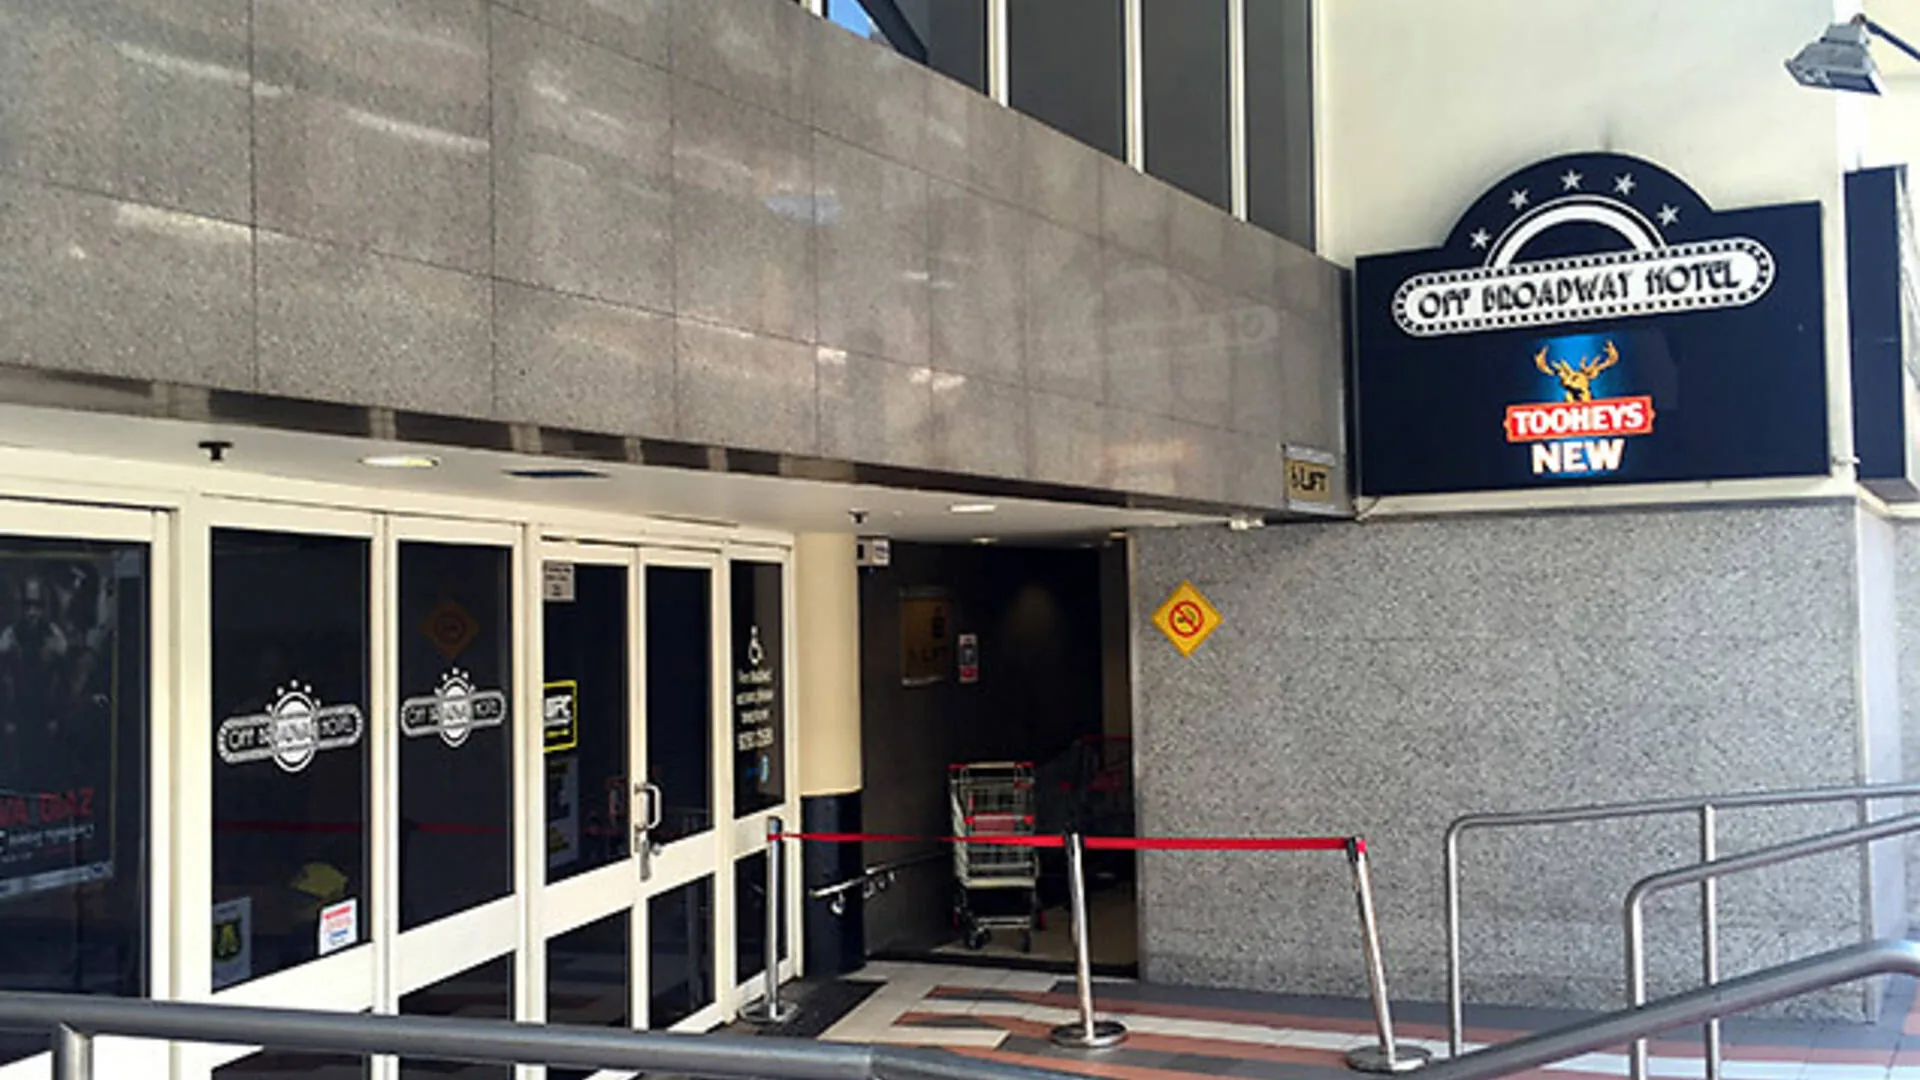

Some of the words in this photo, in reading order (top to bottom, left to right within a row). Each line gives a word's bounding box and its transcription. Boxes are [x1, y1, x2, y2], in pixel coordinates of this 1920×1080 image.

[1418, 286, 1471, 319] OFF
[1481, 269, 1634, 313] BROADWAY
[1645, 259, 1741, 296] HOTEL
[1511, 401, 1645, 436] TOOHEYS
[1531, 437, 1626, 475] NEW
